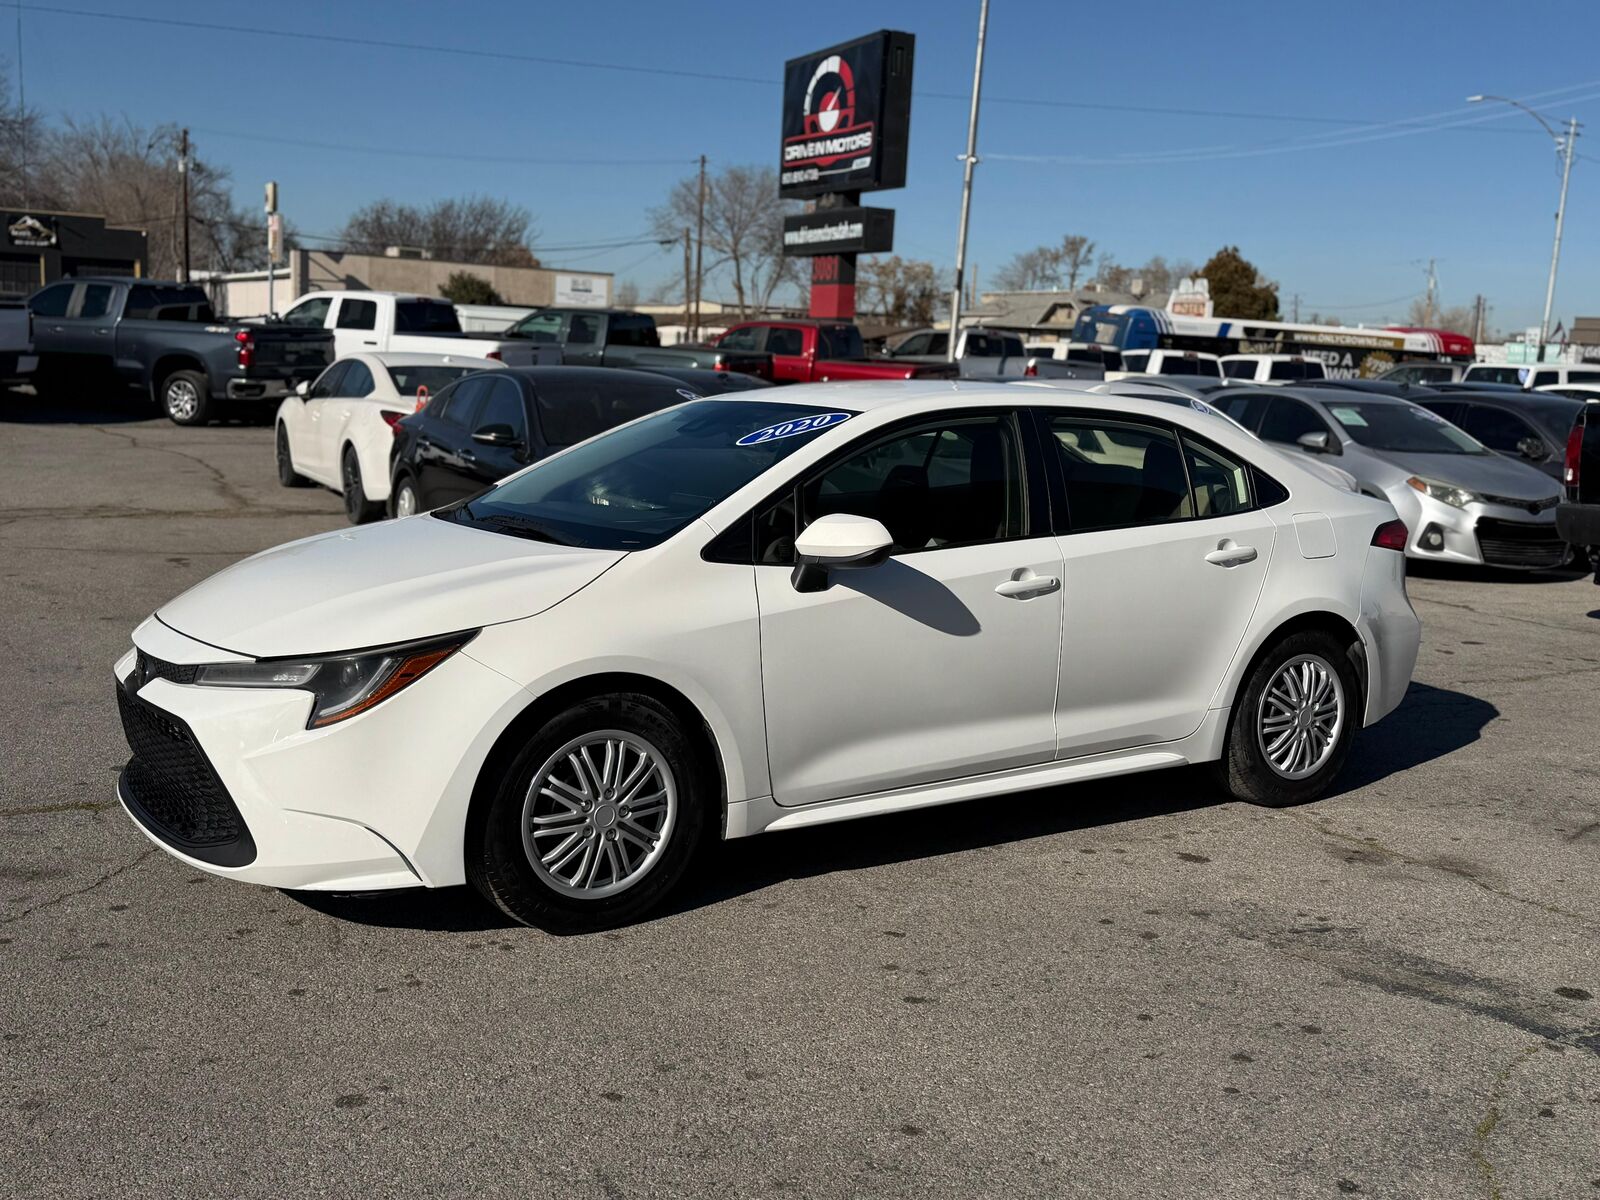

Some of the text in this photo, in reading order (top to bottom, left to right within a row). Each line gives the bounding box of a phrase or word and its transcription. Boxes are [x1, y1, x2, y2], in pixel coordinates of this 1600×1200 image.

[784, 131, 873, 161] DRIVEN MOTORS
[1301, 349, 1354, 367] NEED A
[756, 415, 832, 443] 2020
